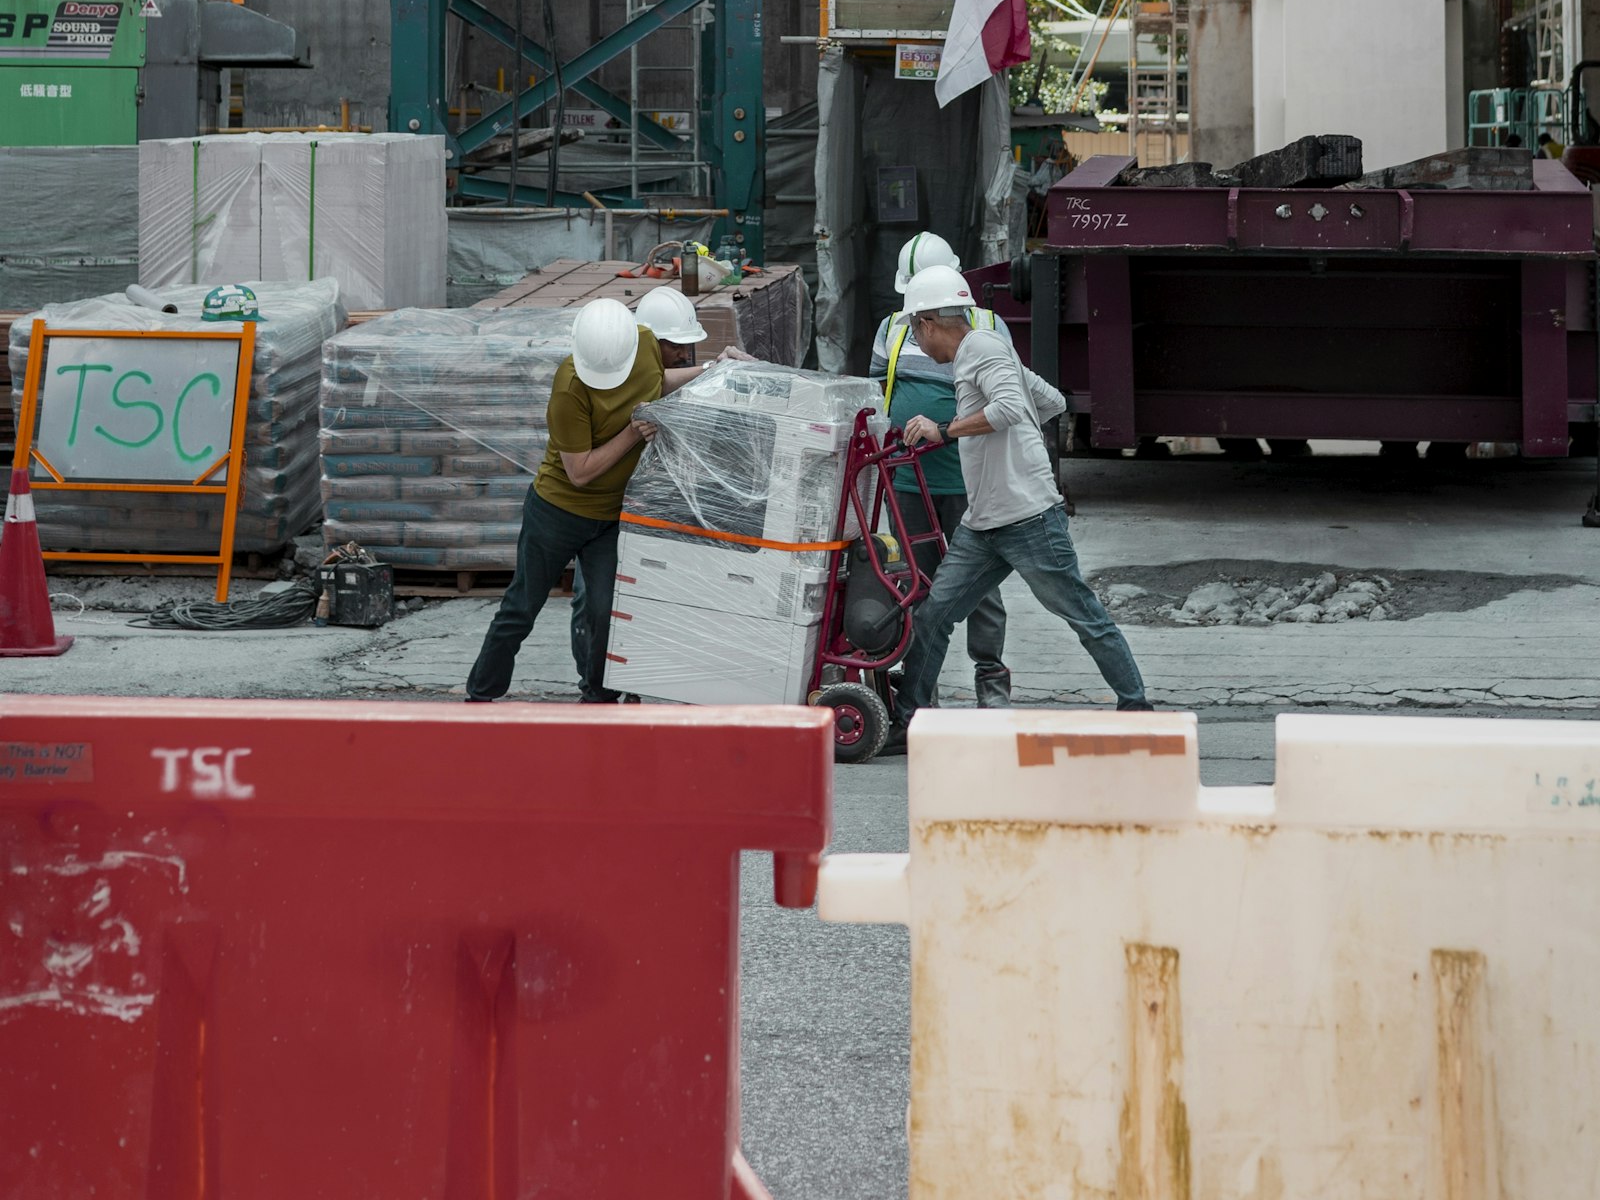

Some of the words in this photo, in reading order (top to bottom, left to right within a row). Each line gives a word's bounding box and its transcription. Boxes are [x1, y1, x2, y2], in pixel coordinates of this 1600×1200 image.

[64, 2, 119, 18] Denyo
[53, 21, 101, 33] SOUND
[67, 33, 114, 45] PROOF
[914, 53, 937, 61] STOP
[552, 113, 596, 126] AETYLENE
[1066, 196, 1092, 211] TRC
[56, 363, 221, 464] TSC
[9, 744, 35, 759] This
[55, 744, 85, 759] NOT
[24, 762, 70, 776] Barrier
[150, 745, 255, 800] TSC
